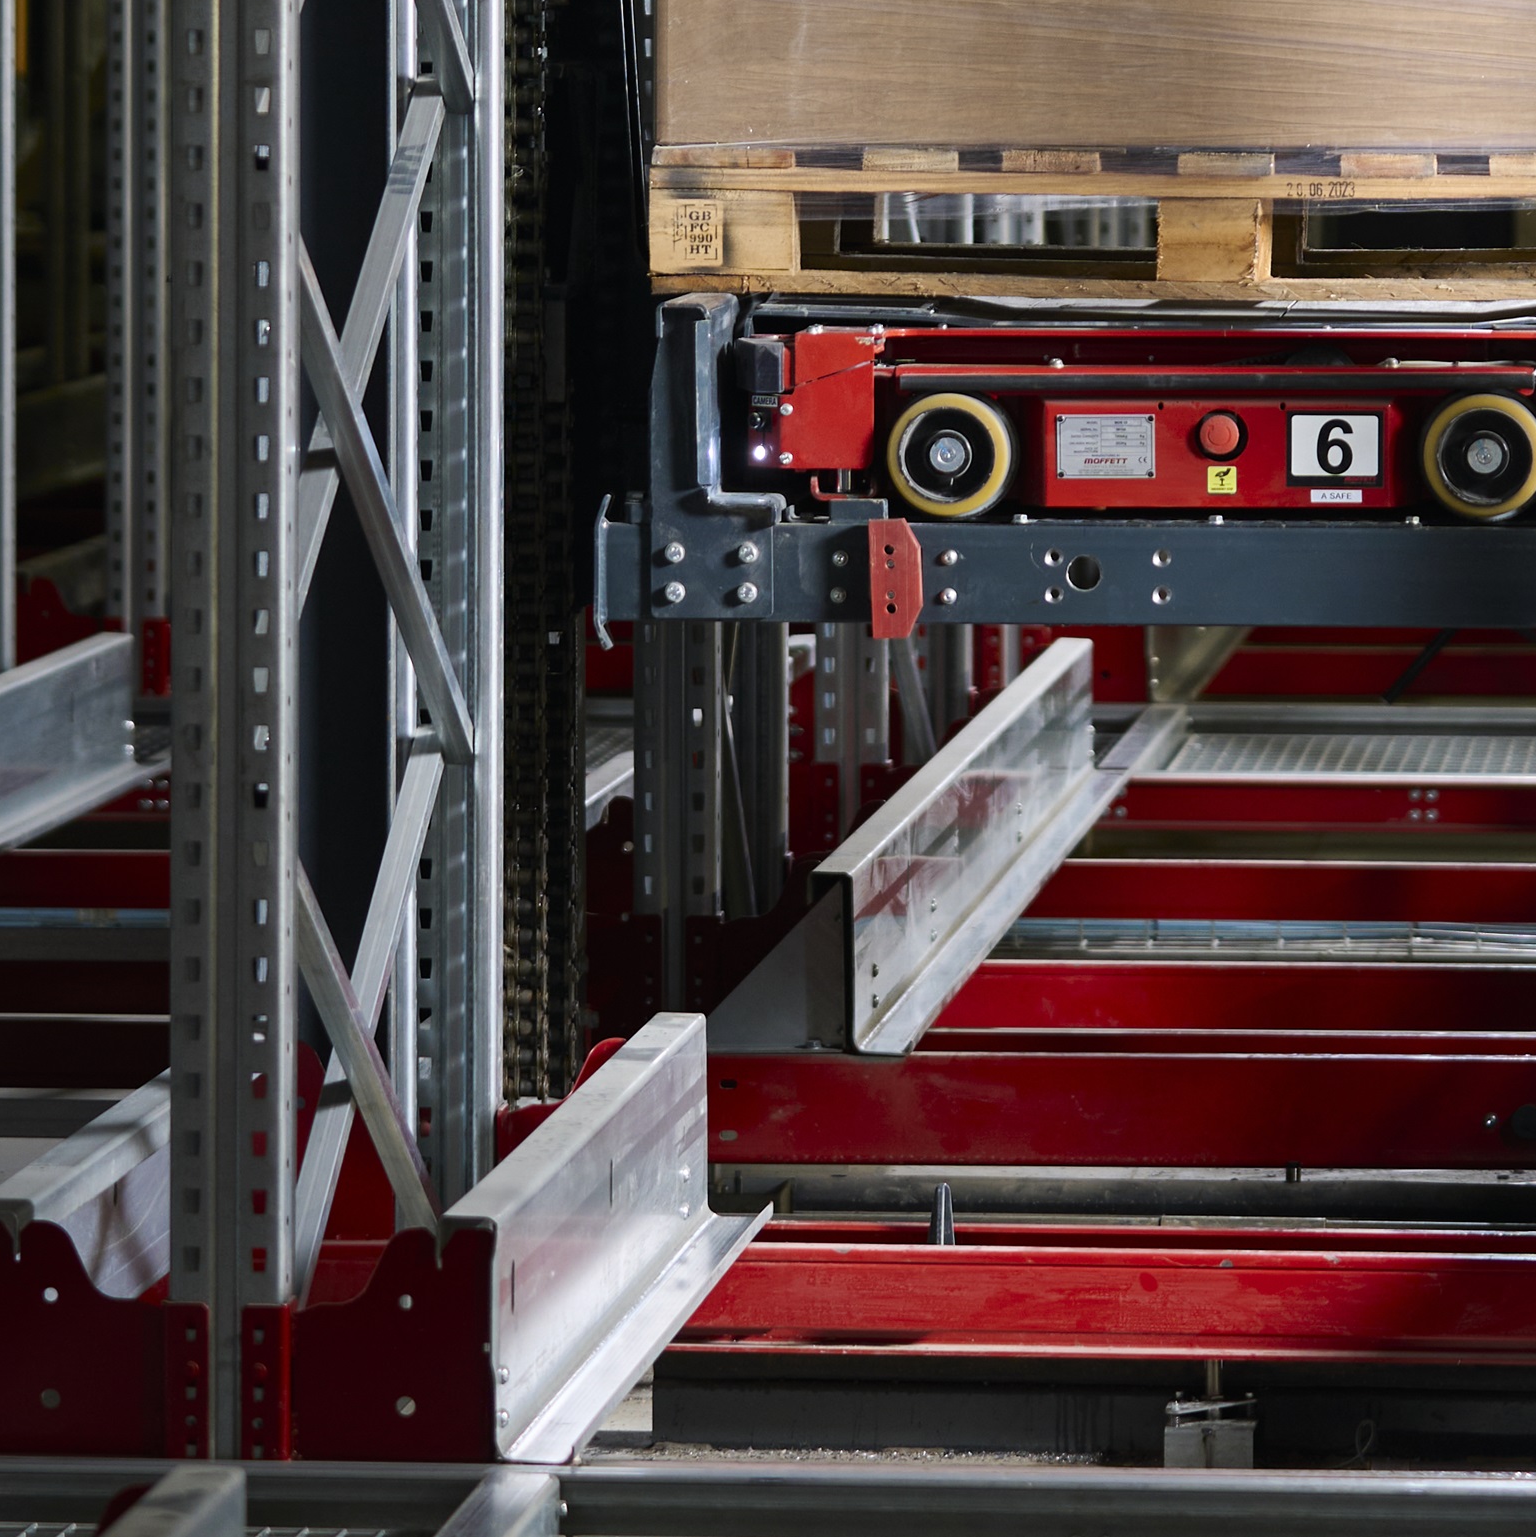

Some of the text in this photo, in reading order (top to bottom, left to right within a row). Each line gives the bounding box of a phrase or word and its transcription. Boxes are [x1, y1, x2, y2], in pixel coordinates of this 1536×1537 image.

[688, 210, 712, 221] GB
[689, 222, 710, 233] FC
[689, 233, 713, 243] 990
[689, 244, 711, 255] HT
[753, 396, 777, 405] CAMERA
[1316, 418, 1354, 475] 6
[1321, 492, 1352, 500] A SAFE
